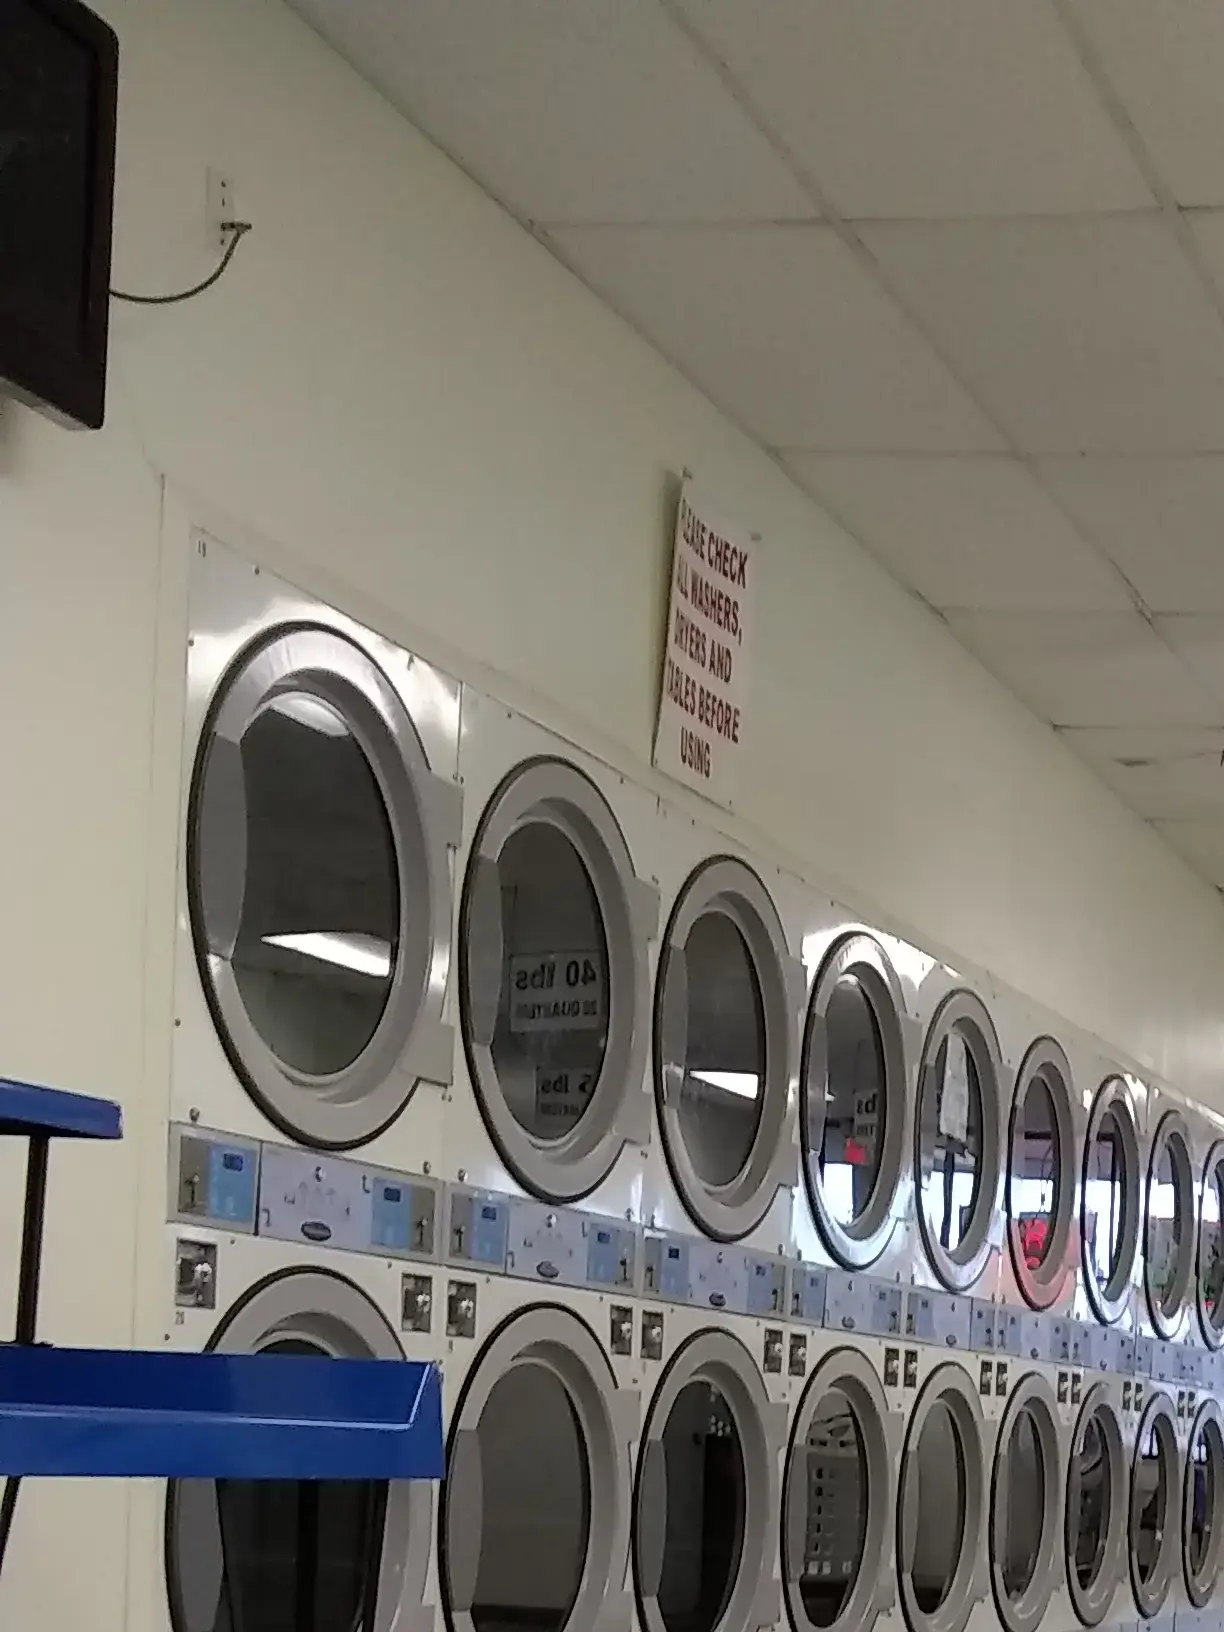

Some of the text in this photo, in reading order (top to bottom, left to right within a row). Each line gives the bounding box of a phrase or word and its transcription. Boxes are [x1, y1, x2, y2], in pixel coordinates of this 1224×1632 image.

[708, 531, 748, 589] CHECK
[674, 606, 732, 683] DRYERS AND
[690, 566, 743, 646] WASHERS,
[667, 656, 741, 744] TABLES BEFORE
[680, 725, 711, 779] USING
